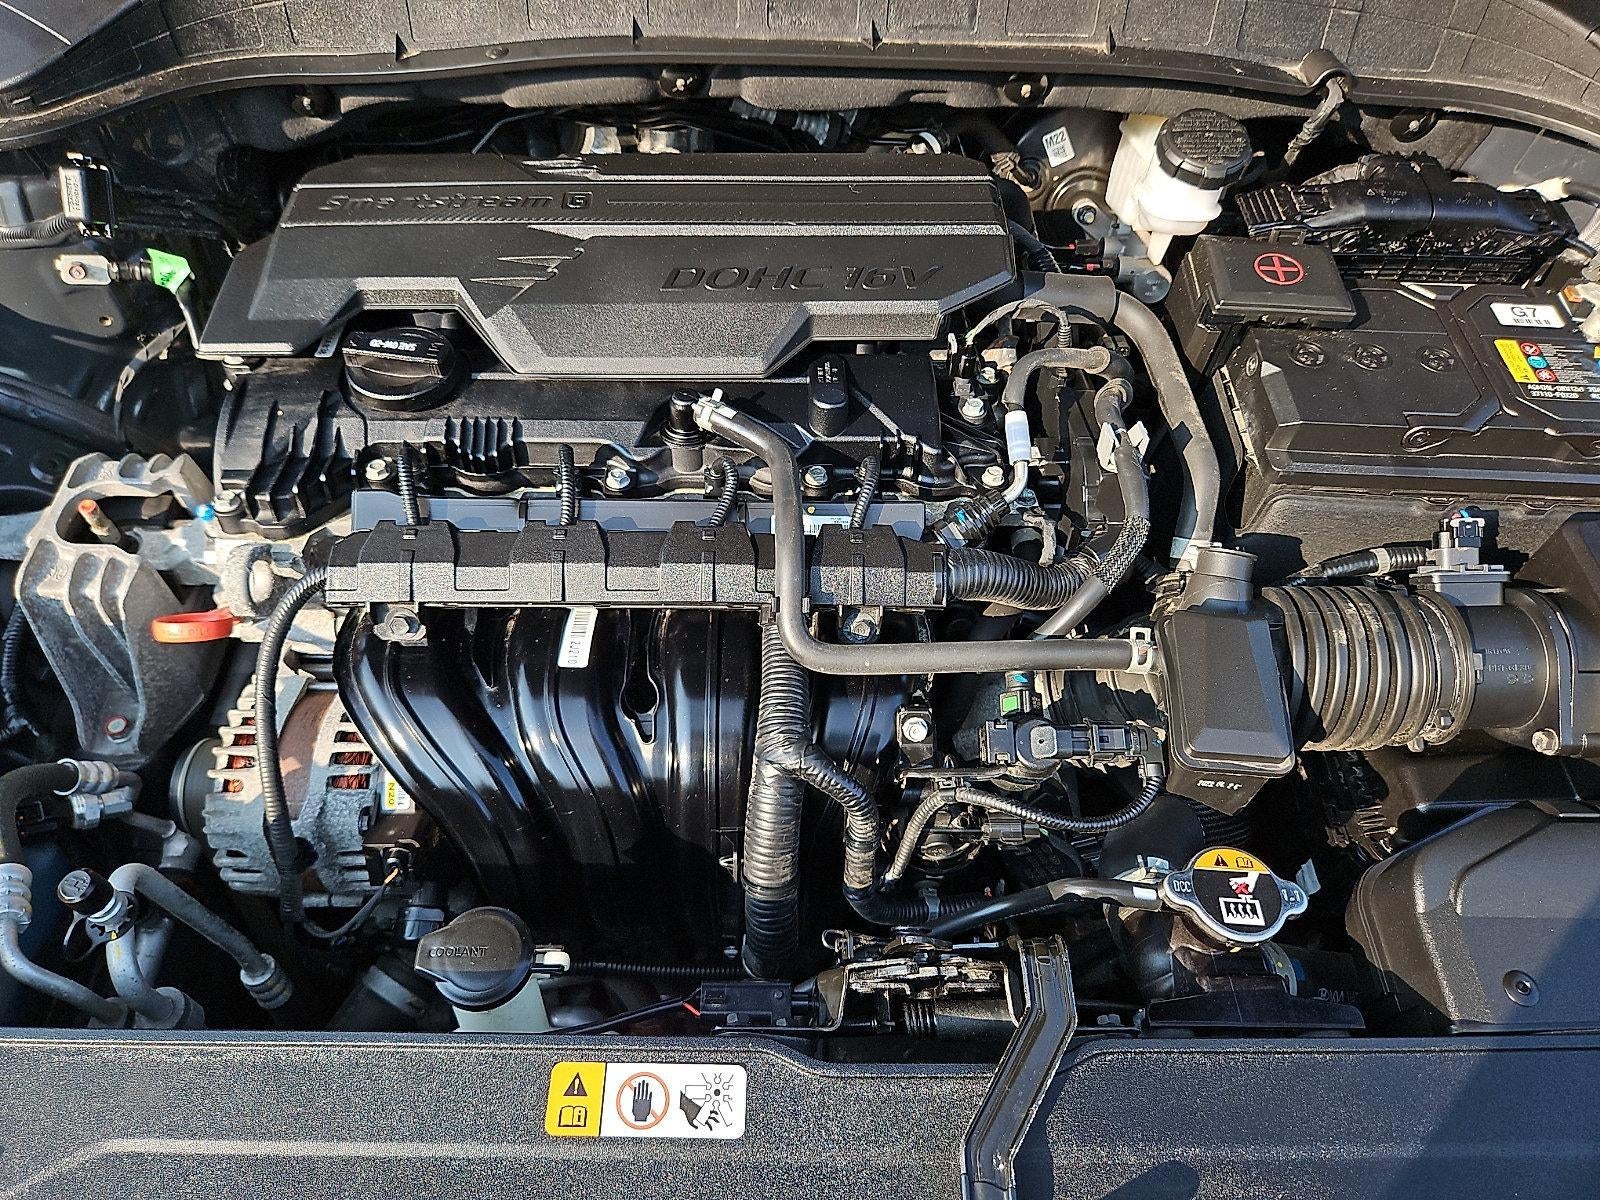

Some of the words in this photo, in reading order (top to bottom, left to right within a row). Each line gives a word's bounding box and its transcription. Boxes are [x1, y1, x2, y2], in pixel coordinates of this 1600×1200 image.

[317, 193, 554, 210] Smartstream
[659, 265, 831, 292] DOHC
[844, 265, 944, 291] 16V
[1510, 305, 1537, 318] G7
[388, 782, 396, 805] N20
[1172, 879, 1192, 893] DCC
[429, 945, 489, 957] COOLANT
